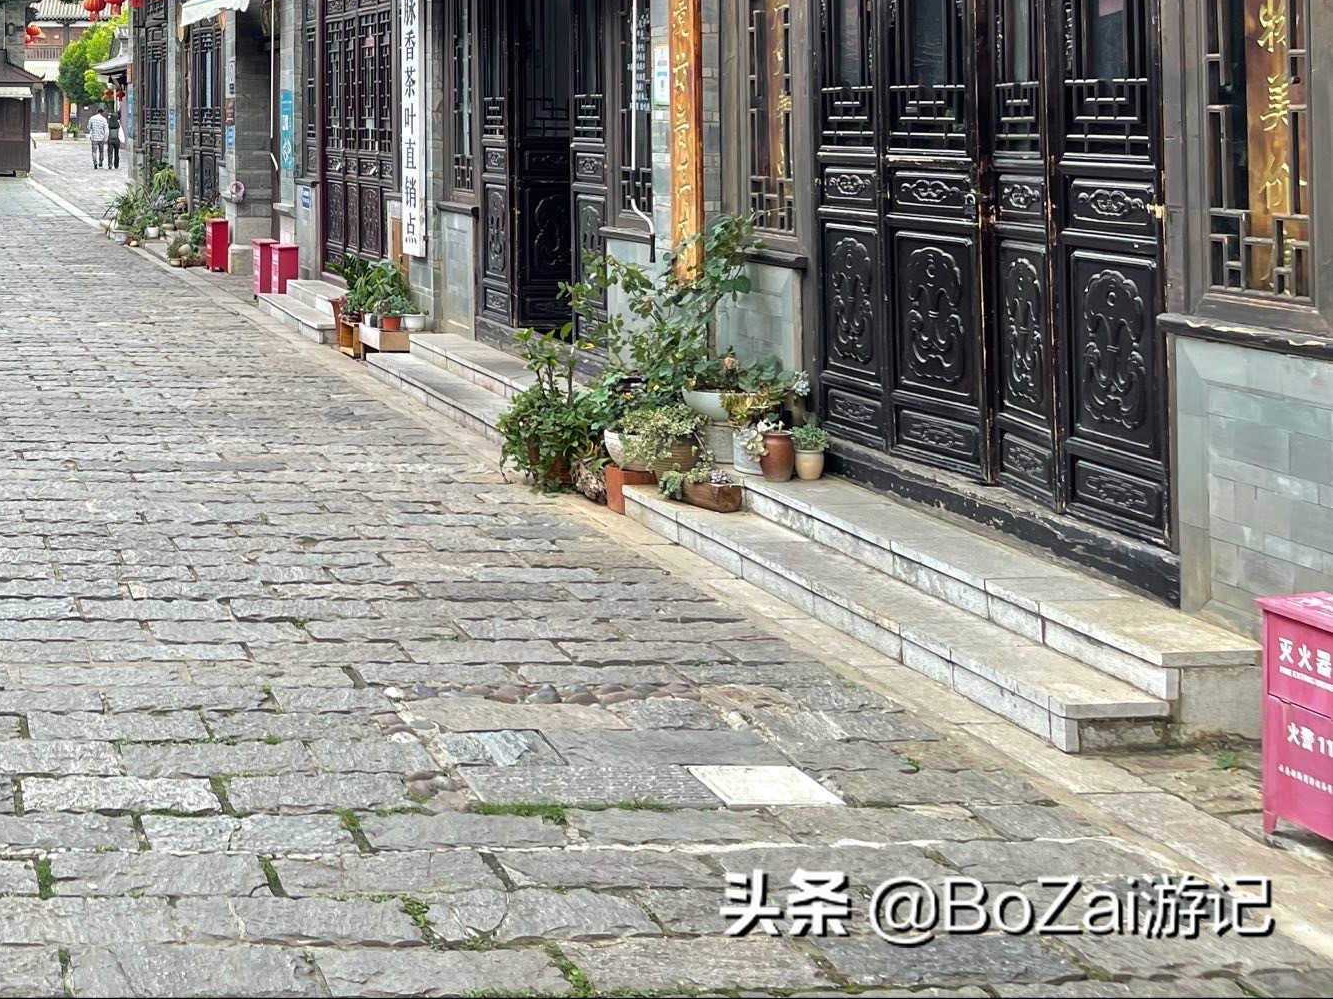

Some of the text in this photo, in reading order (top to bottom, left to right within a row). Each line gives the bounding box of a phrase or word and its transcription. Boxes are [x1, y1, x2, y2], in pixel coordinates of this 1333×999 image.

[1278, 637, 1332, 679] 灭火器
[1286, 721, 1316, 752] 火警
